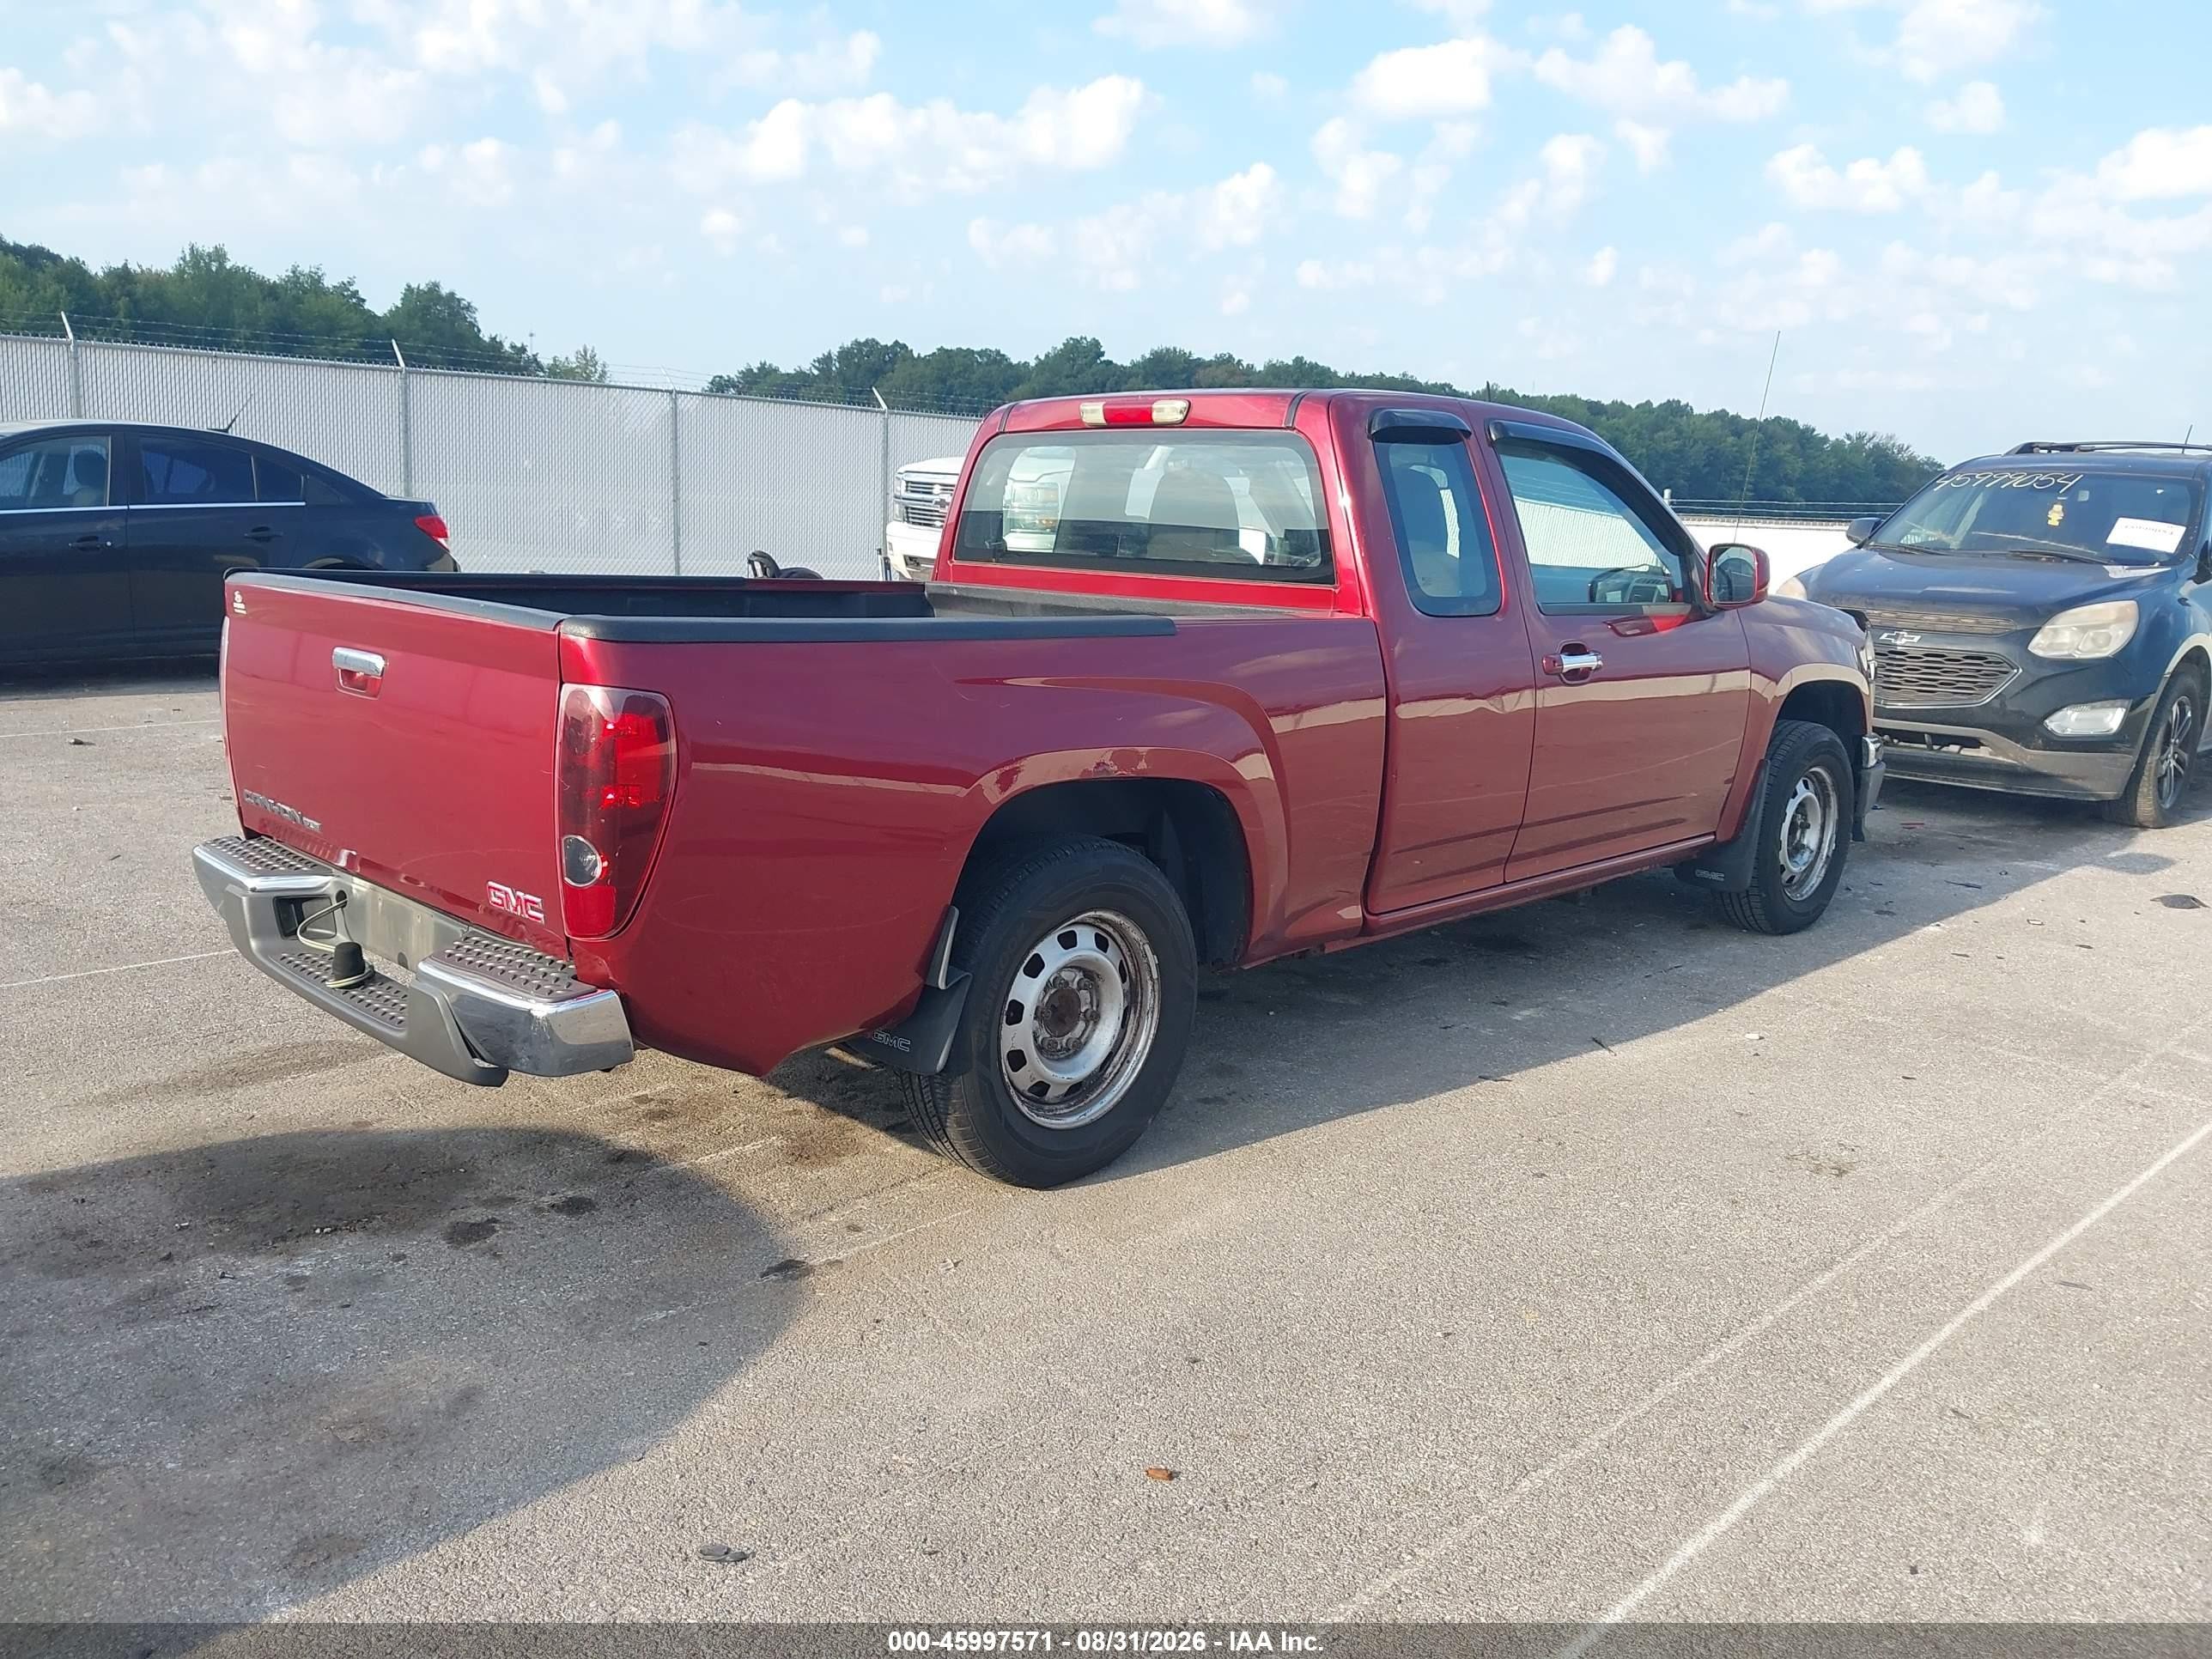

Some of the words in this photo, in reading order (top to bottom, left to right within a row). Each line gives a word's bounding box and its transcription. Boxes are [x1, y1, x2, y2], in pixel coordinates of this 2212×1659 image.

[1934, 472, 2083, 494] 45999054
[487, 881, 544, 925] GMC
[872, 1030, 910, 1052] GMC
